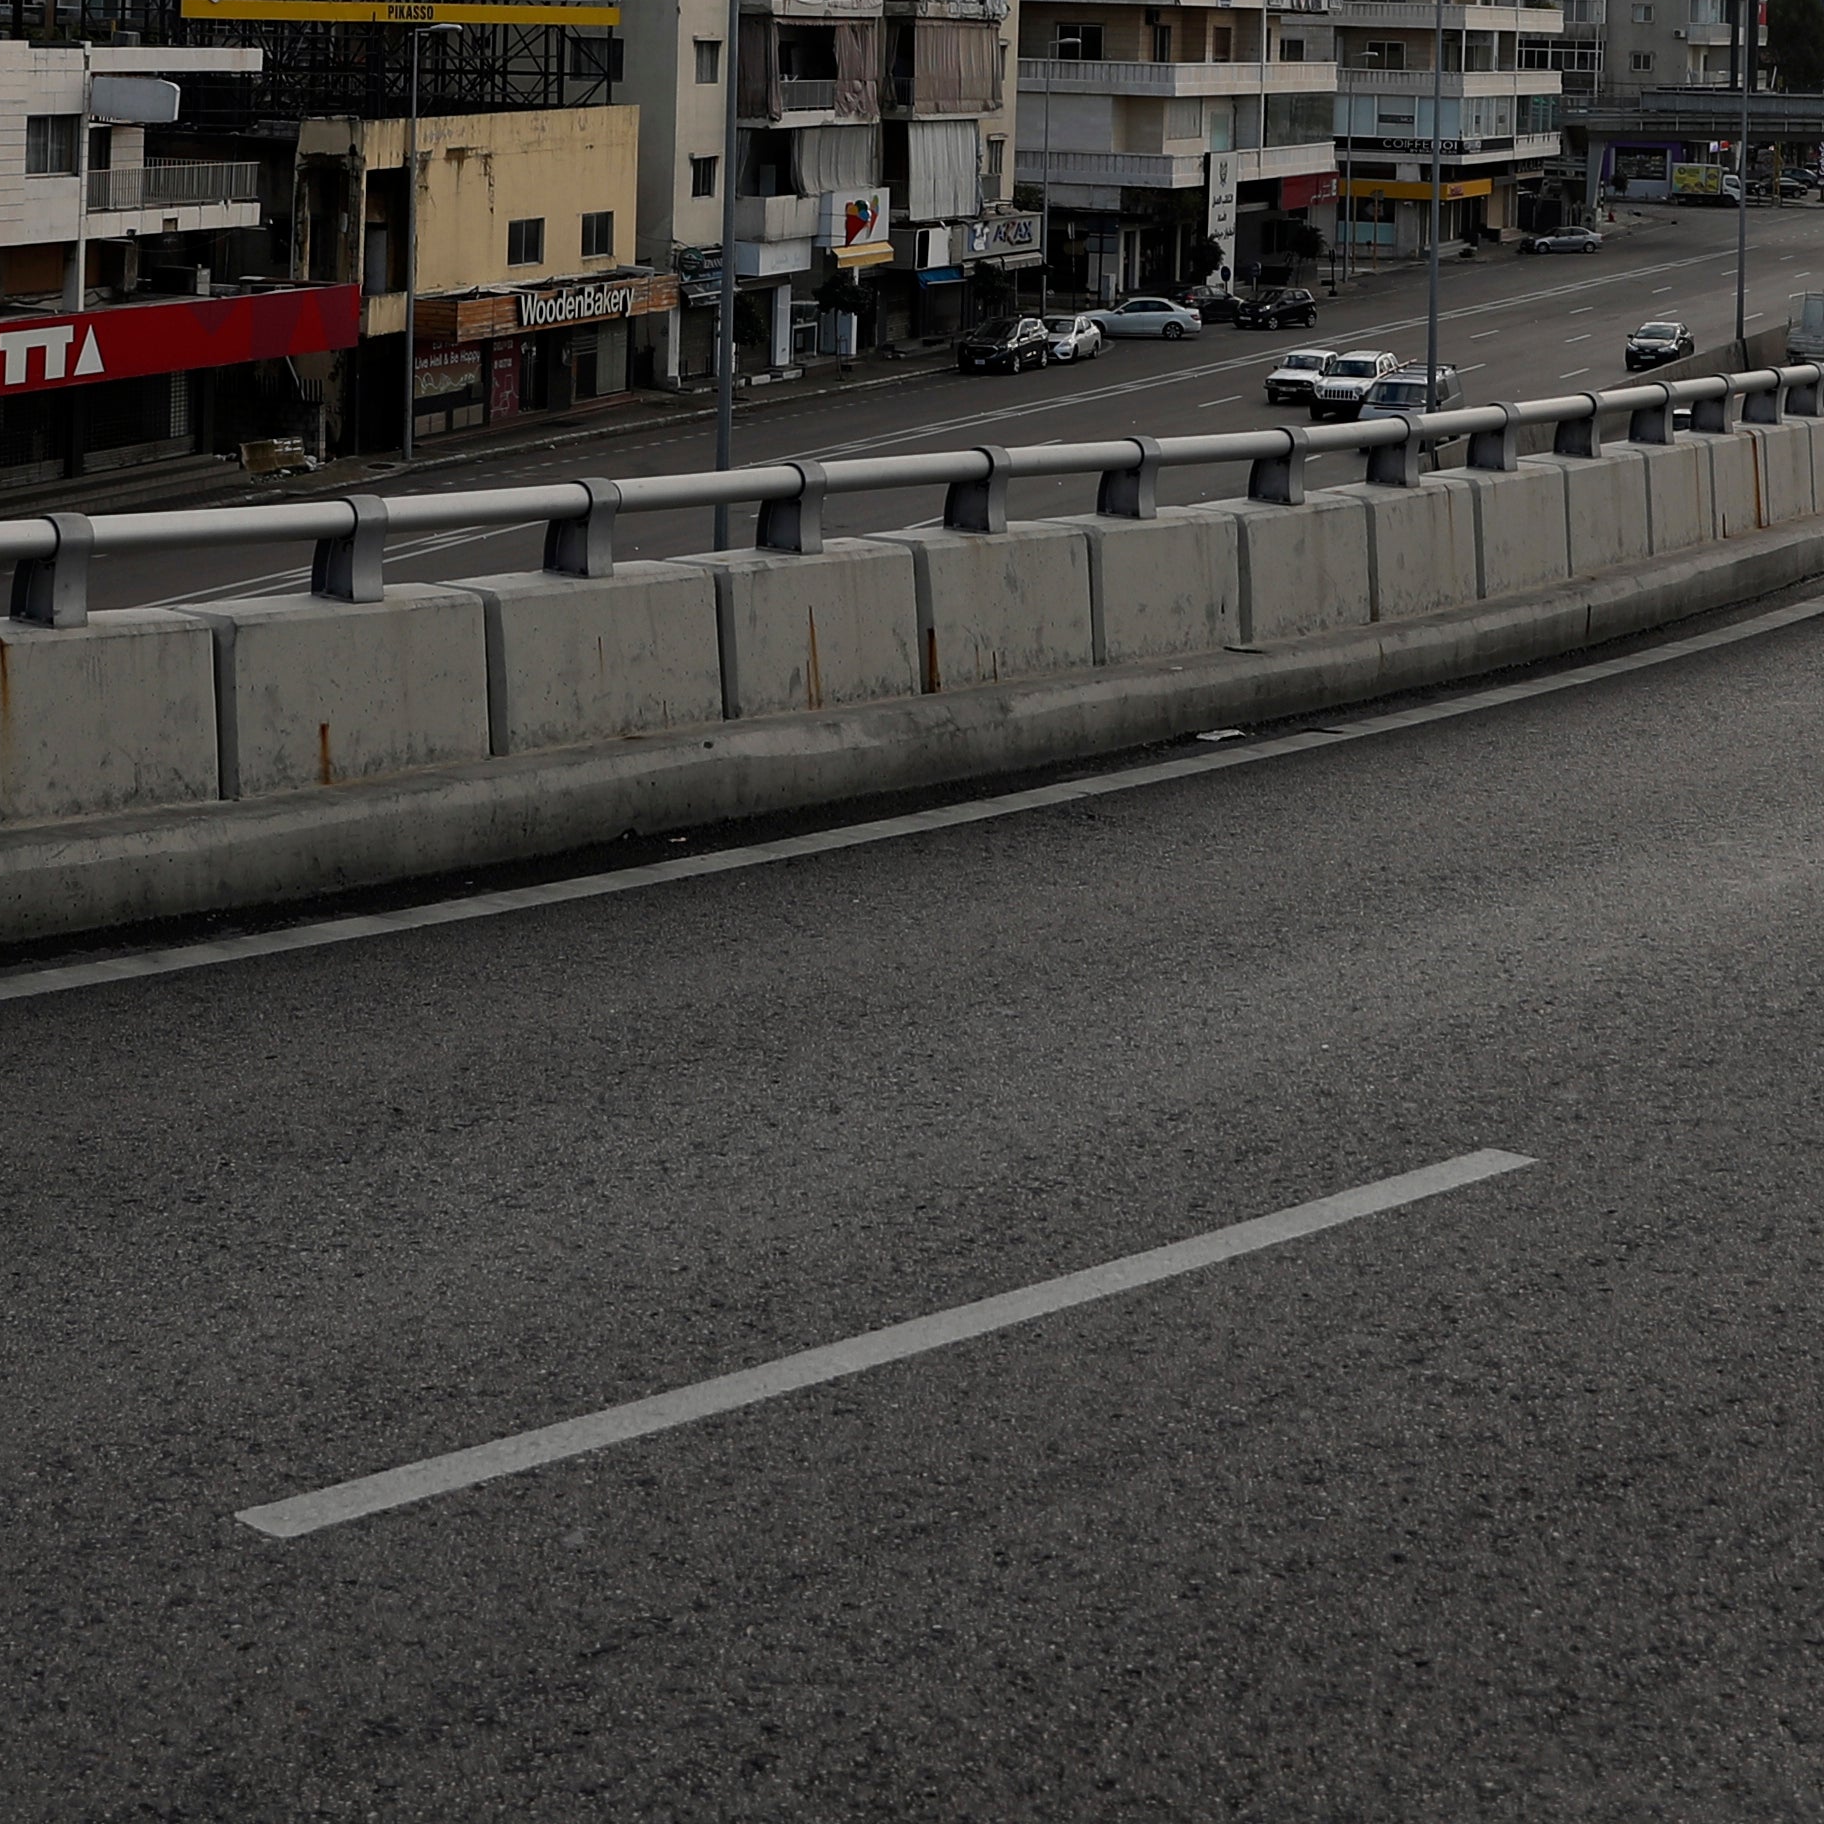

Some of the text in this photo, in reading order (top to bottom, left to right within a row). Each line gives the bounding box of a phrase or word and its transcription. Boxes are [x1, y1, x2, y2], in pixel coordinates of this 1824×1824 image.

[387, 5, 434, 20] PIKASSO
[520, 284, 635, 327] WoodenBakery
[449, 351, 459, 364] Be
[459, 349, 481, 365] Happy
